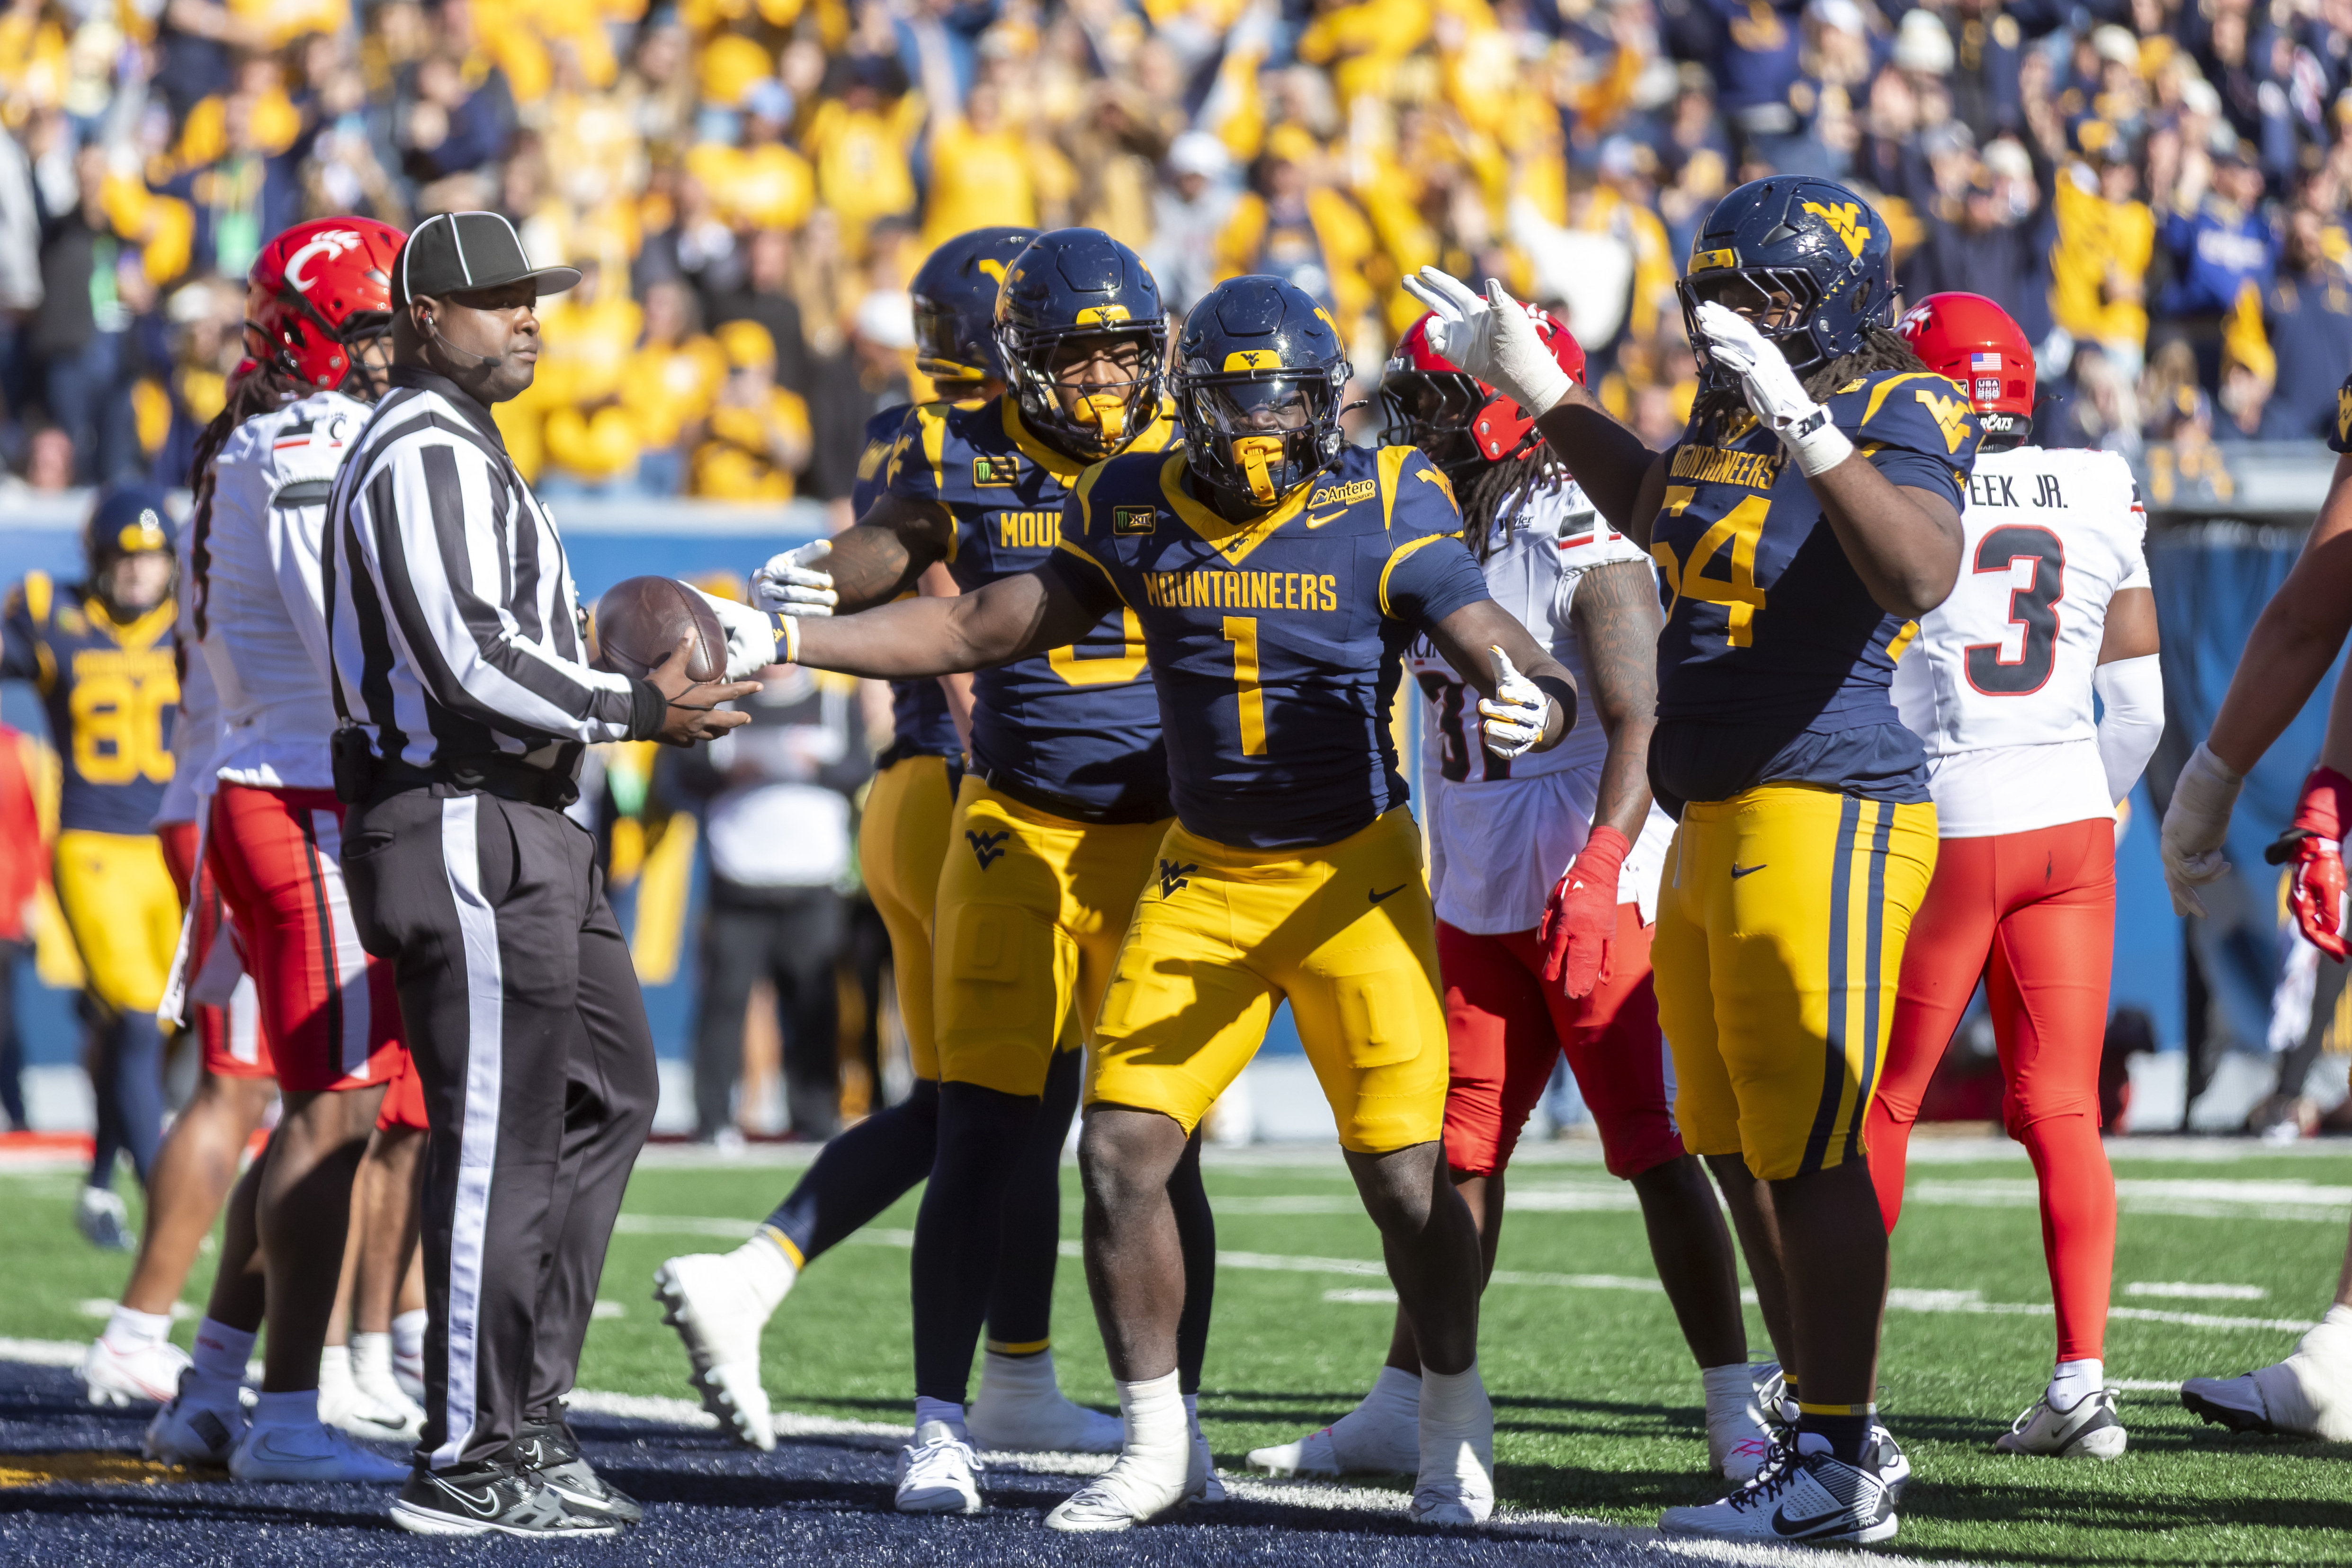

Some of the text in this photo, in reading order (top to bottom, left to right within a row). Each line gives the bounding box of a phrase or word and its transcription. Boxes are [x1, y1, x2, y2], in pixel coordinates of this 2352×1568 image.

[1979, 413, 2013, 431] RCATS
[1328, 481, 1373, 501] Antero
[1347, 492, 1373, 502] Resources
[1969, 474, 2068, 508] EEK JR.
[1650, 485, 1771, 647] 54
[1142, 571, 1337, 611] MOUNTAINEERS
[1964, 523, 2066, 697] 3
[1223, 616, 1267, 756] 1
[1849, 1515, 1880, 1530] ALPHA
